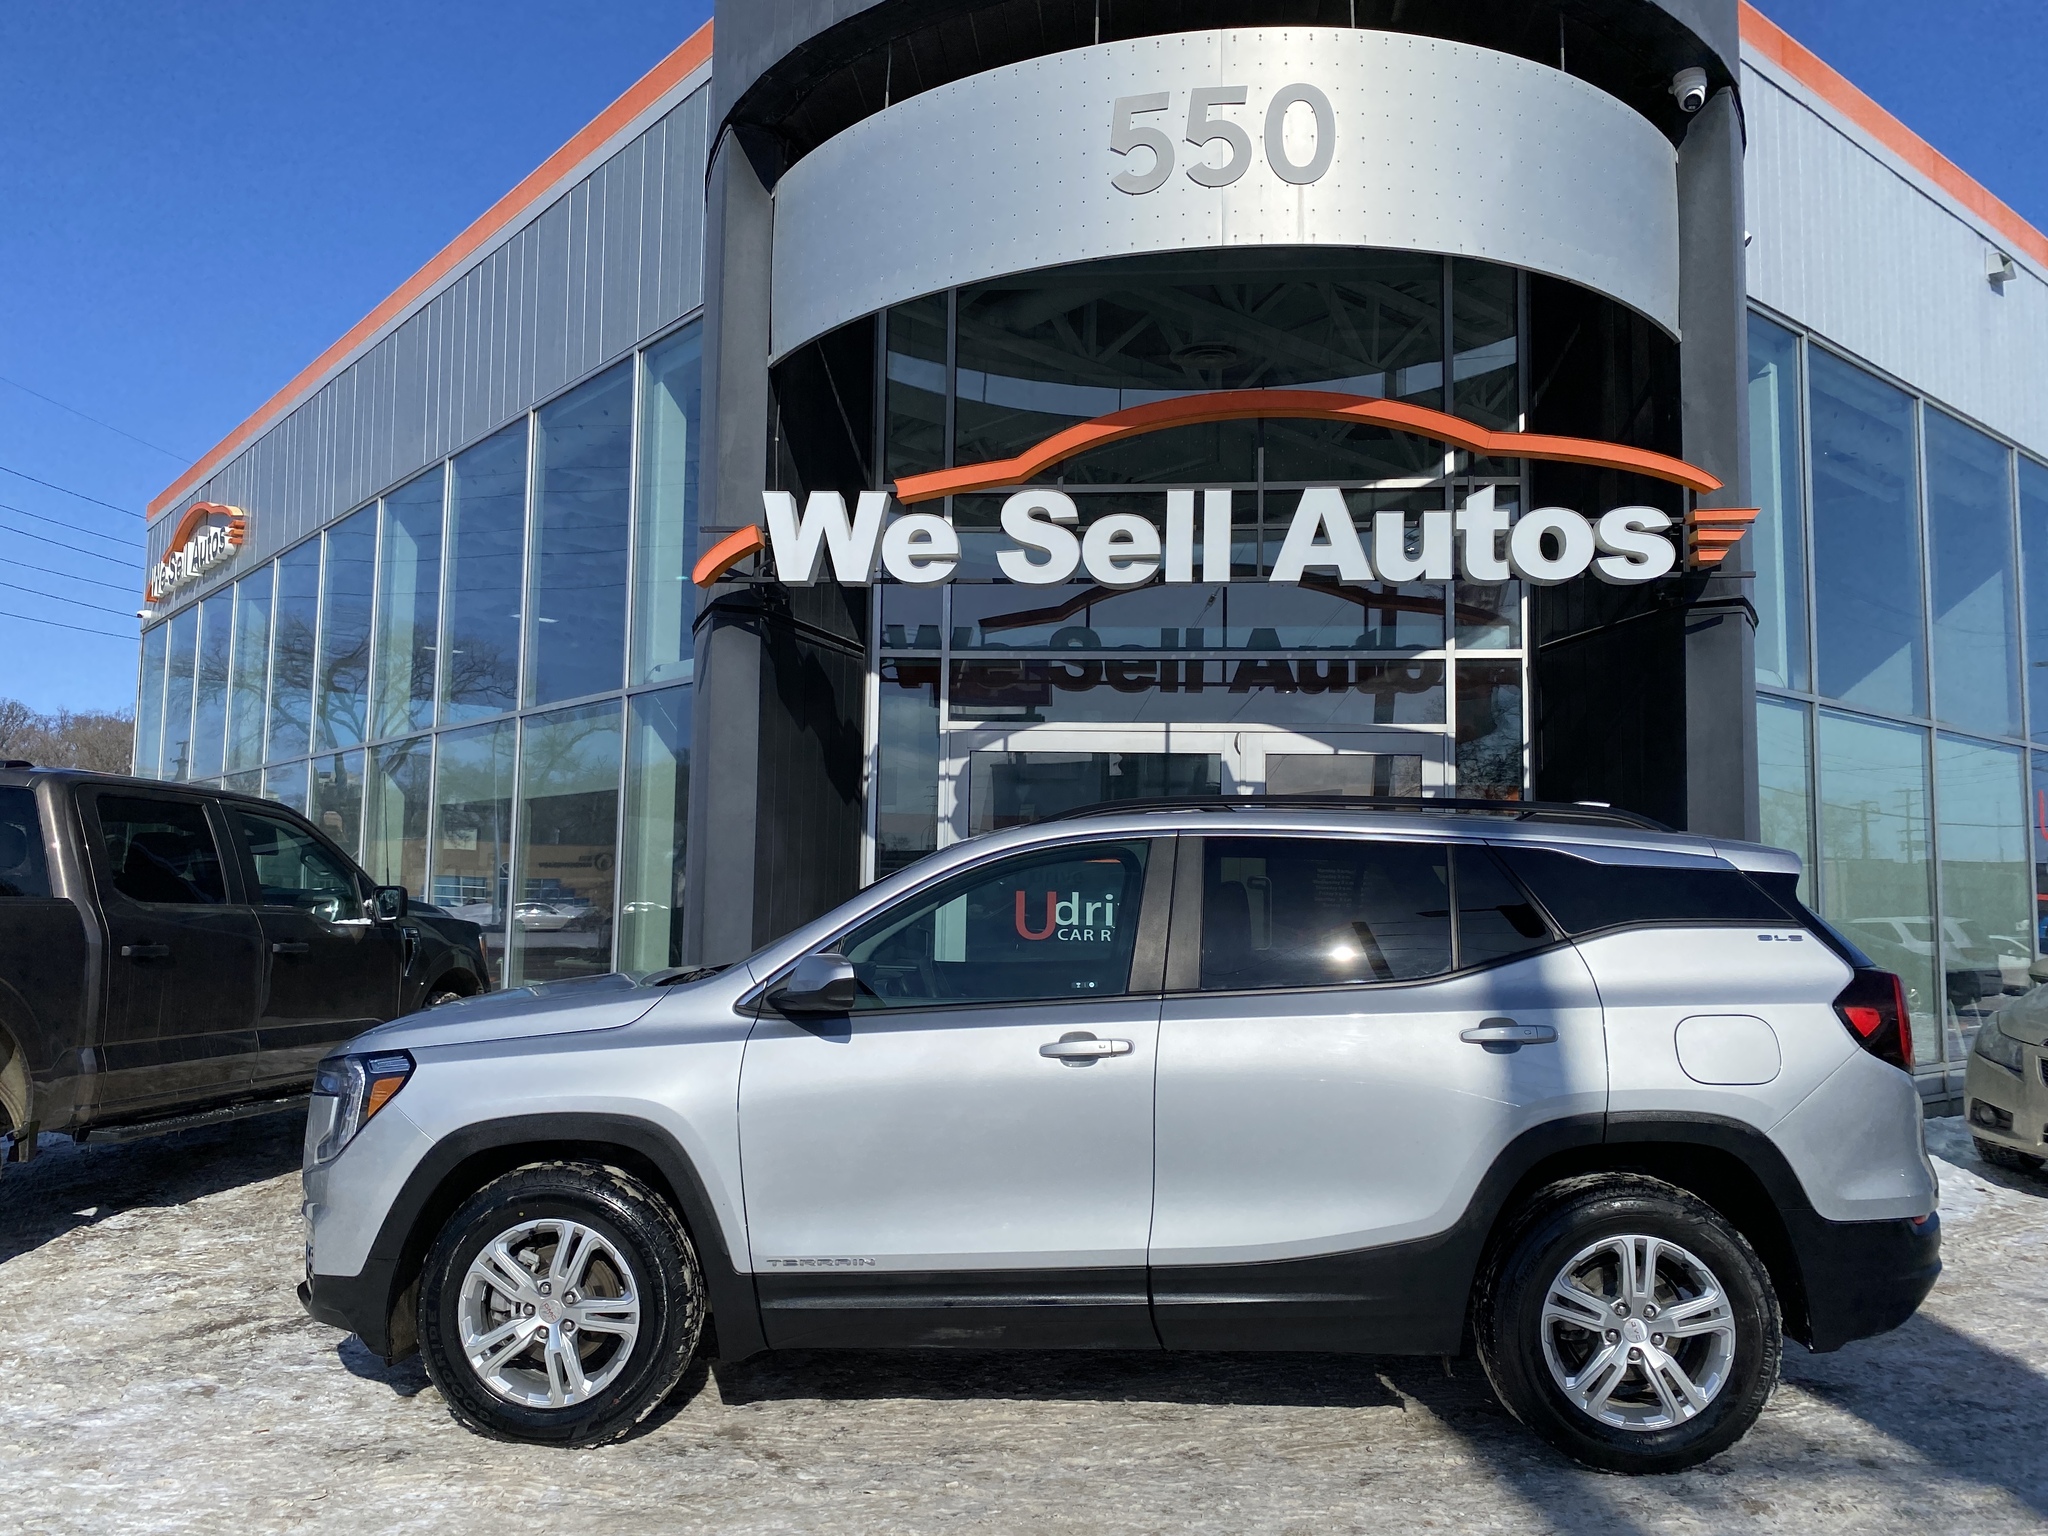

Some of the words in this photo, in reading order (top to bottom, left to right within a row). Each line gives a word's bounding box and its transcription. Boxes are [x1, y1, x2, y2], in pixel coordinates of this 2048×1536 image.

[1110, 83, 1336, 195] 550
[762, 488, 961, 588] We
[996, 487, 1232, 589] Sell
[1268, 484, 1678, 586] Autos
[1015, 890, 1114, 941] Udri
[1057, 928, 1094, 941] CAR
[1100, 929, 1112, 942] R
[766, 1258, 876, 1267] TERRAIN
